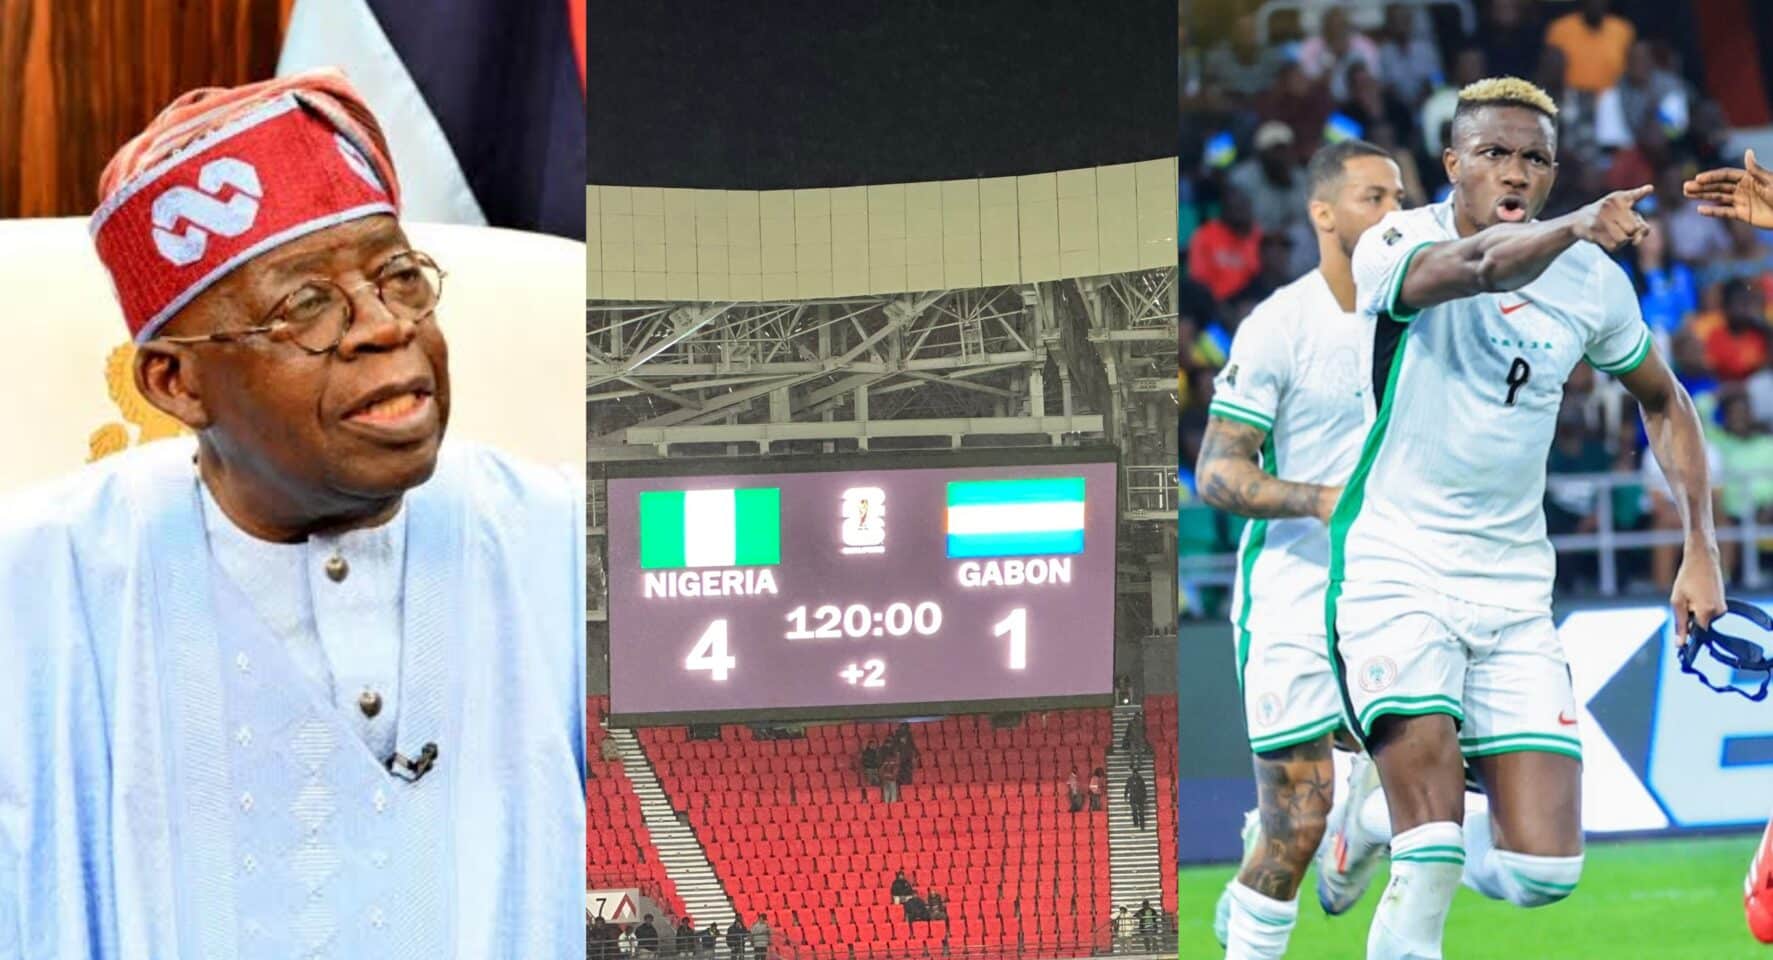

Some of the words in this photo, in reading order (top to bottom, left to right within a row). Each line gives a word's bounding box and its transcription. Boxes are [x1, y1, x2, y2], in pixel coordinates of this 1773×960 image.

[1506, 356, 1530, 407] 9
[644, 569, 779, 598] NIGERIA
[958, 558, 1071, 587] GABON
[785, 601, 943, 640] 120:00
[685, 619, 736, 681] 4
[993, 607, 1027, 669] 1
[839, 658, 886, 688] +2
[595, 897, 607, 918] 7
